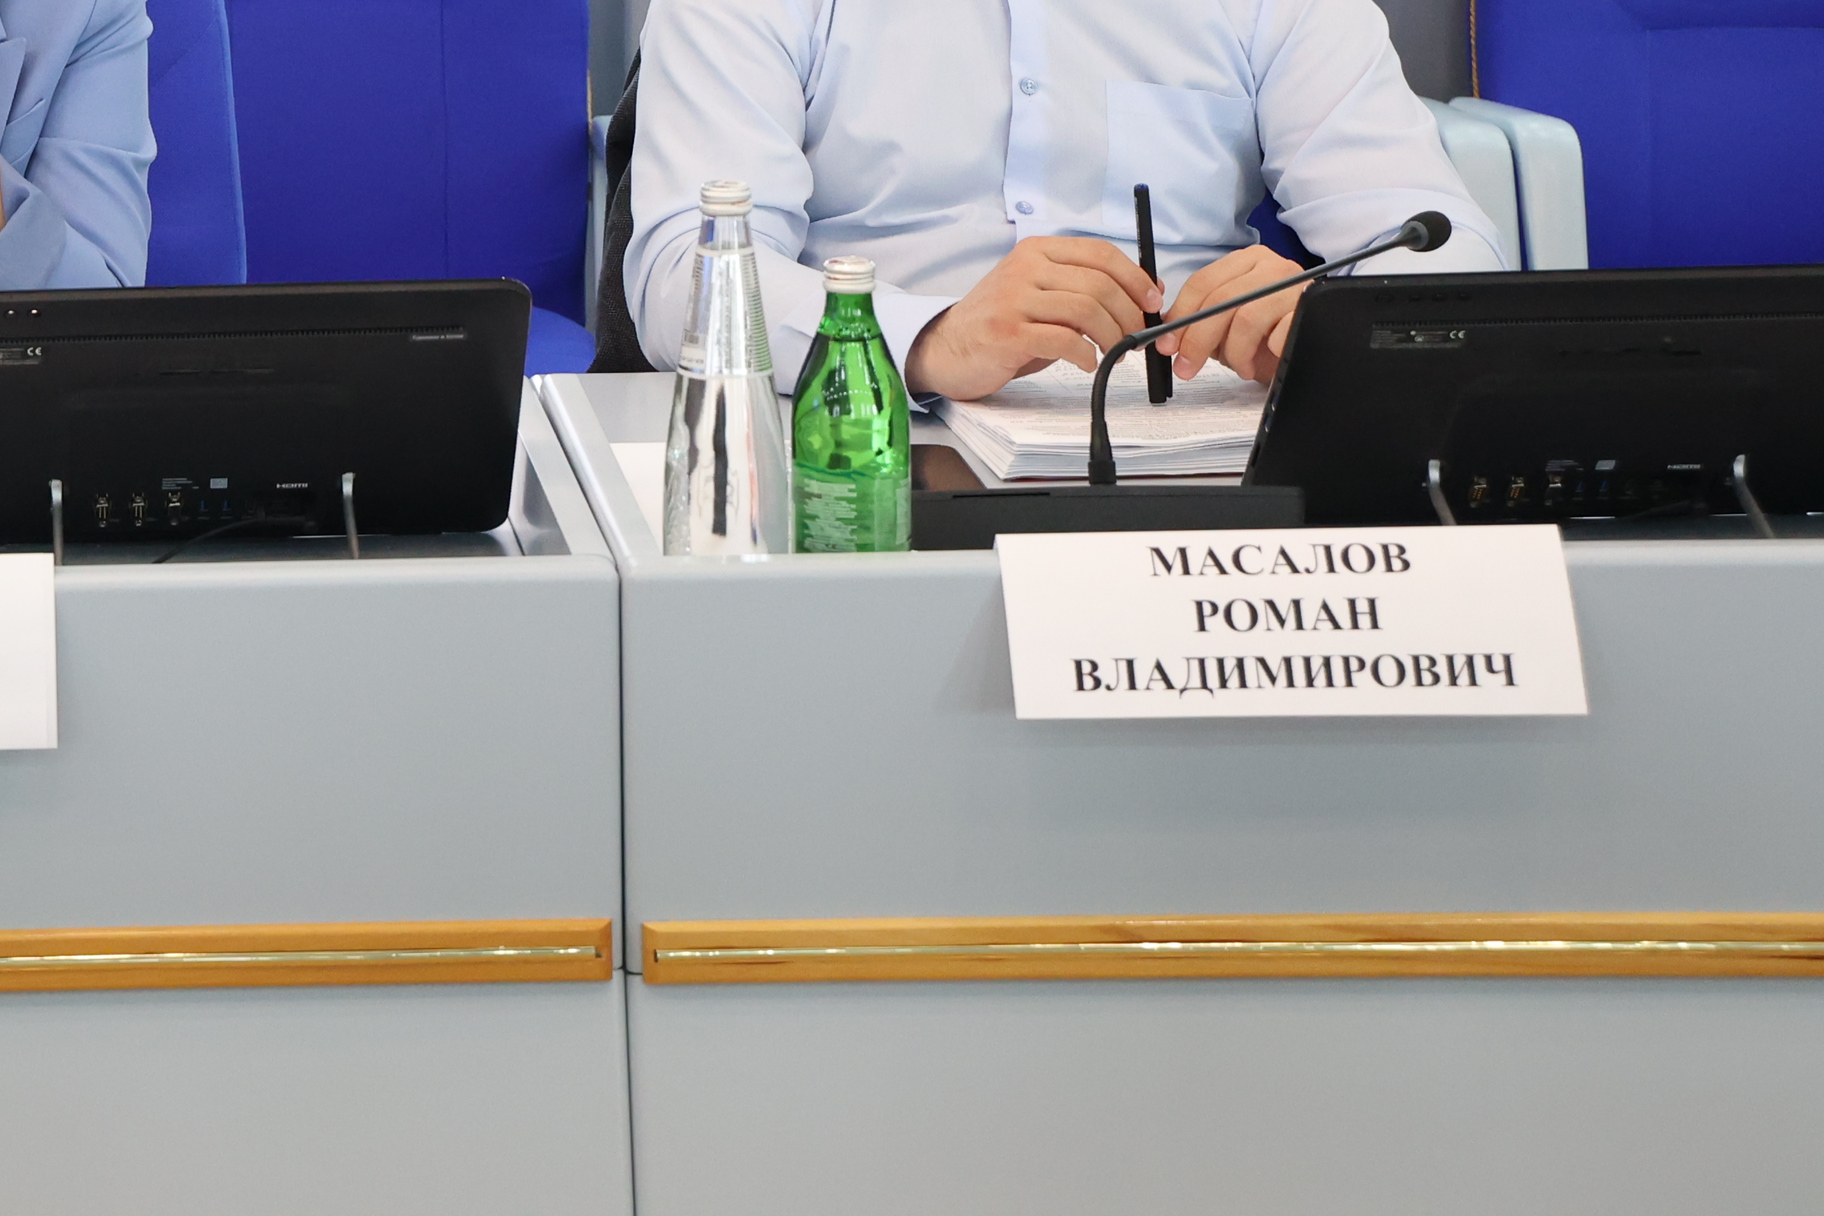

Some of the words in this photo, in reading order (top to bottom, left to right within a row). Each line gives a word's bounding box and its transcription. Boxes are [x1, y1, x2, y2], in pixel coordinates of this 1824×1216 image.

[1150, 543, 1410, 576] МАСАЛОВ
[1194, 597, 1381, 632] РОМАН
[1073, 653, 1517, 697] ВЛАДИМИРОВИЧ
